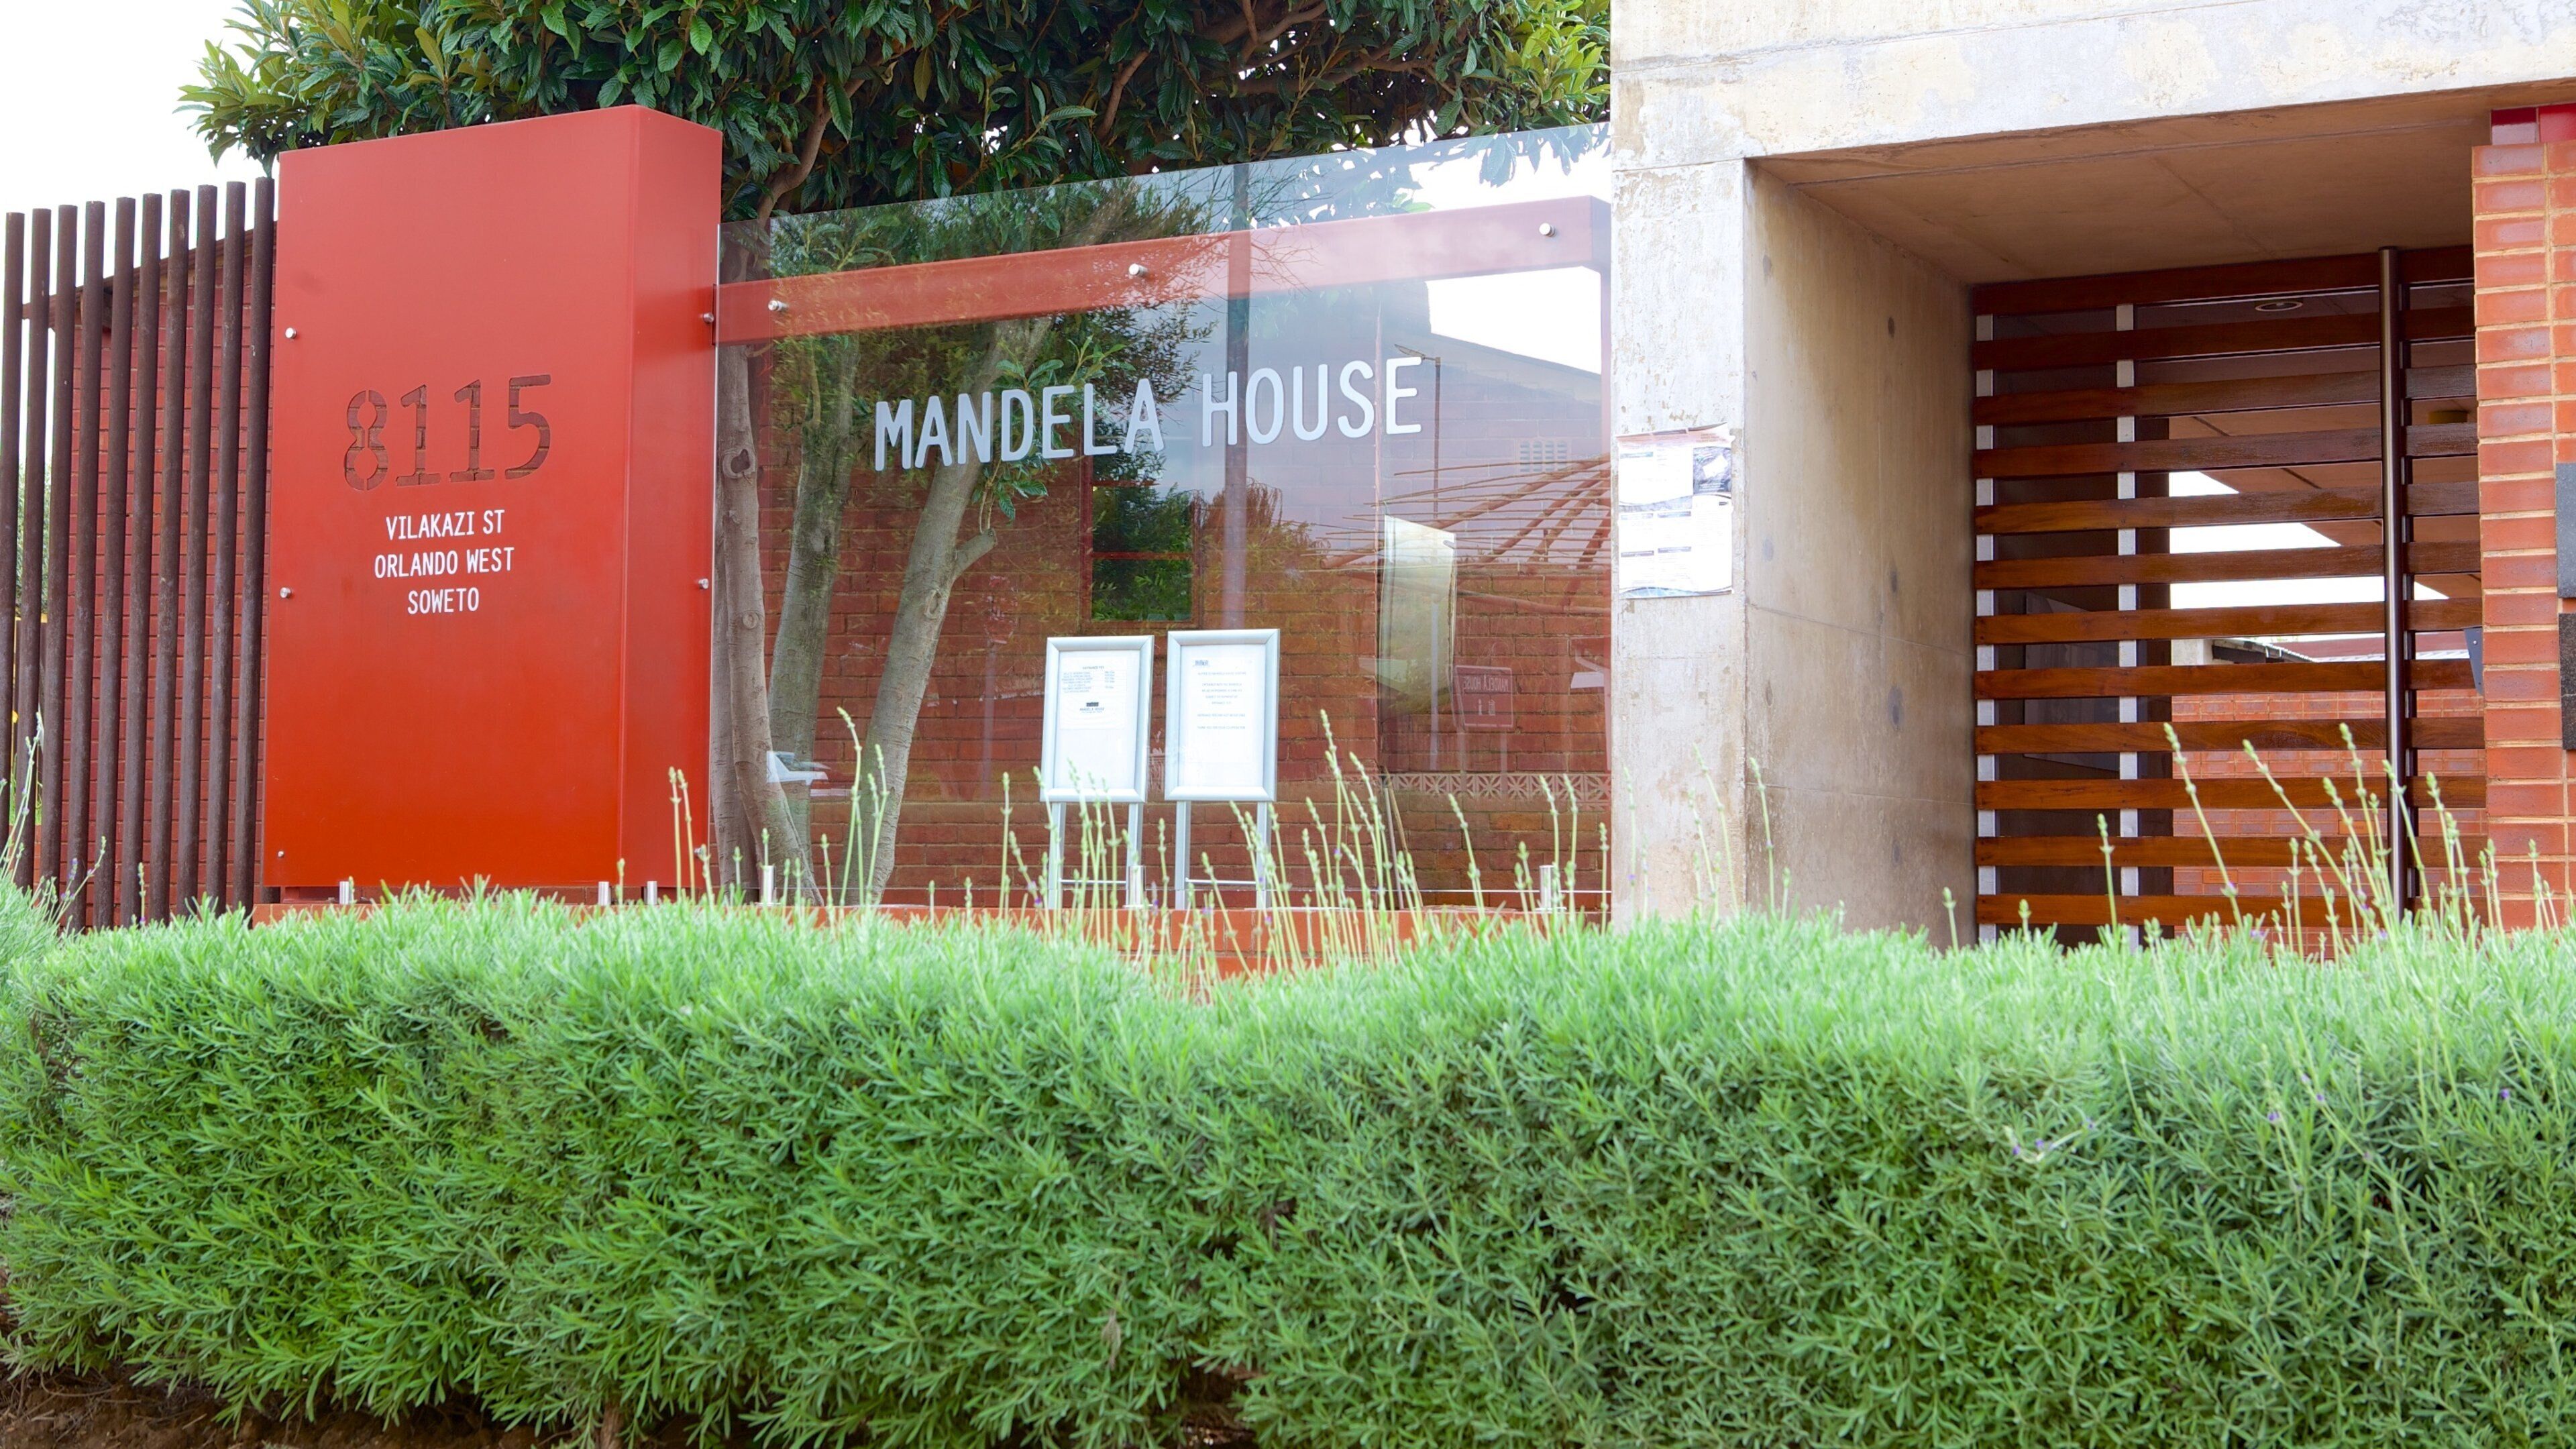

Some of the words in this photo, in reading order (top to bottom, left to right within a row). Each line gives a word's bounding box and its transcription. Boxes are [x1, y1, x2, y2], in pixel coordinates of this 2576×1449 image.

[875, 378, 1165, 472] MANDELA
[1201, 356, 1422, 447] HOUSE
[343, 374, 551, 491] 8115
[386, 512, 476, 540] VILAKAZI
[482, 509, 505, 535] ST
[374, 551, 458, 579] ORLANDO
[466, 547, 515, 574] WEST
[407, 588, 480, 614] SOWETO
